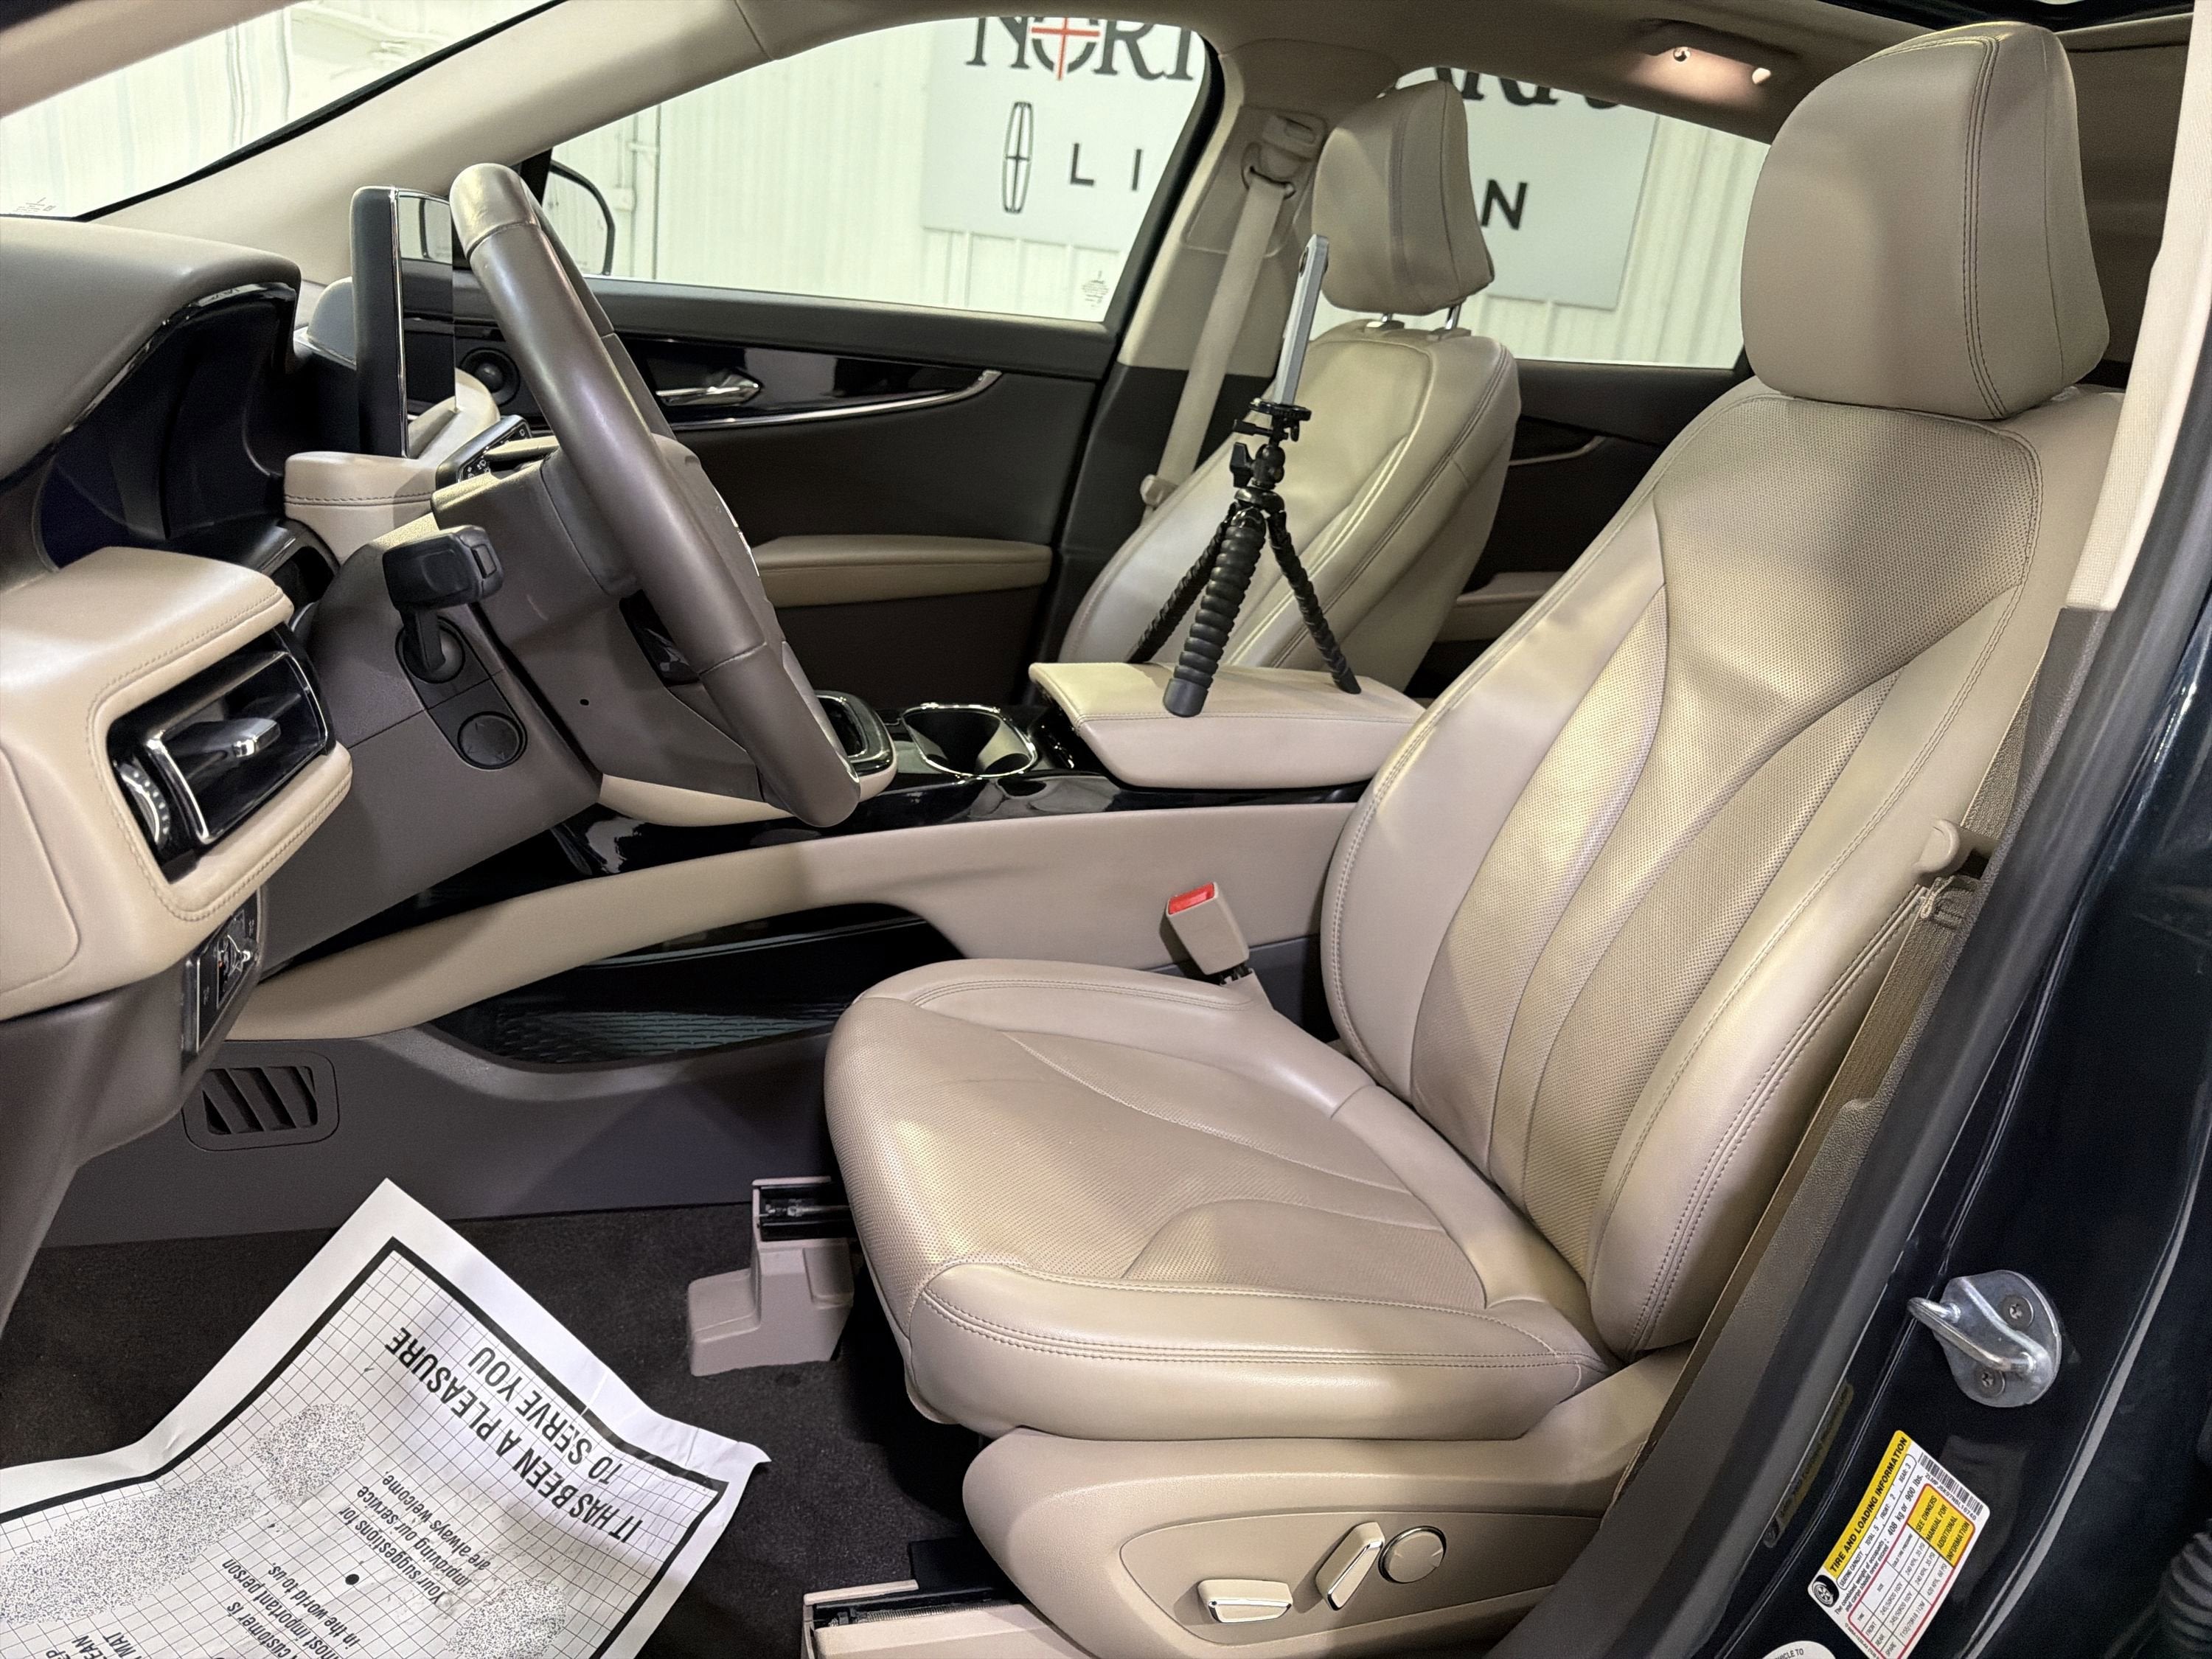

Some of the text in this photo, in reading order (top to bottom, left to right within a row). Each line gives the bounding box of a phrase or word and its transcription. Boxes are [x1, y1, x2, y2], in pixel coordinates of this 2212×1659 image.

[384, 1327, 643, 1543] IT HAS BEEN A PLEASURE
[467, 1347, 623, 1484] TO SERVE YOU
[1905, 1461, 1911, 1470] 3
[382, 1471, 490, 1571] are always welcome.
[1830, 1436, 1907, 1572] TIRE AND LOADING INFORMATION
[1886, 1472, 1923, 1537] 408 kg or 900 lbs.
[1916, 1495, 1937, 1532] SEE OWNERS
[1925, 1503, 1947, 1542] MANUAL FOR
[339, 1506, 446, 1604] Your suggestions for
[357, 1486, 471, 1590] improving our service
[1936, 1514, 1958, 1550] ADDITIONAL
[1946, 1520, 1969, 1561] INFORMATION
[222, 1559, 265, 1594] person
[226, 1601, 291, 1658] customer is
[252, 1590, 311, 1641] important
[268, 1562, 361, 1649] in the world to us.
[102, 1632, 136, 1658] MAT
[1795, 1648, 1804, 1656] TO
